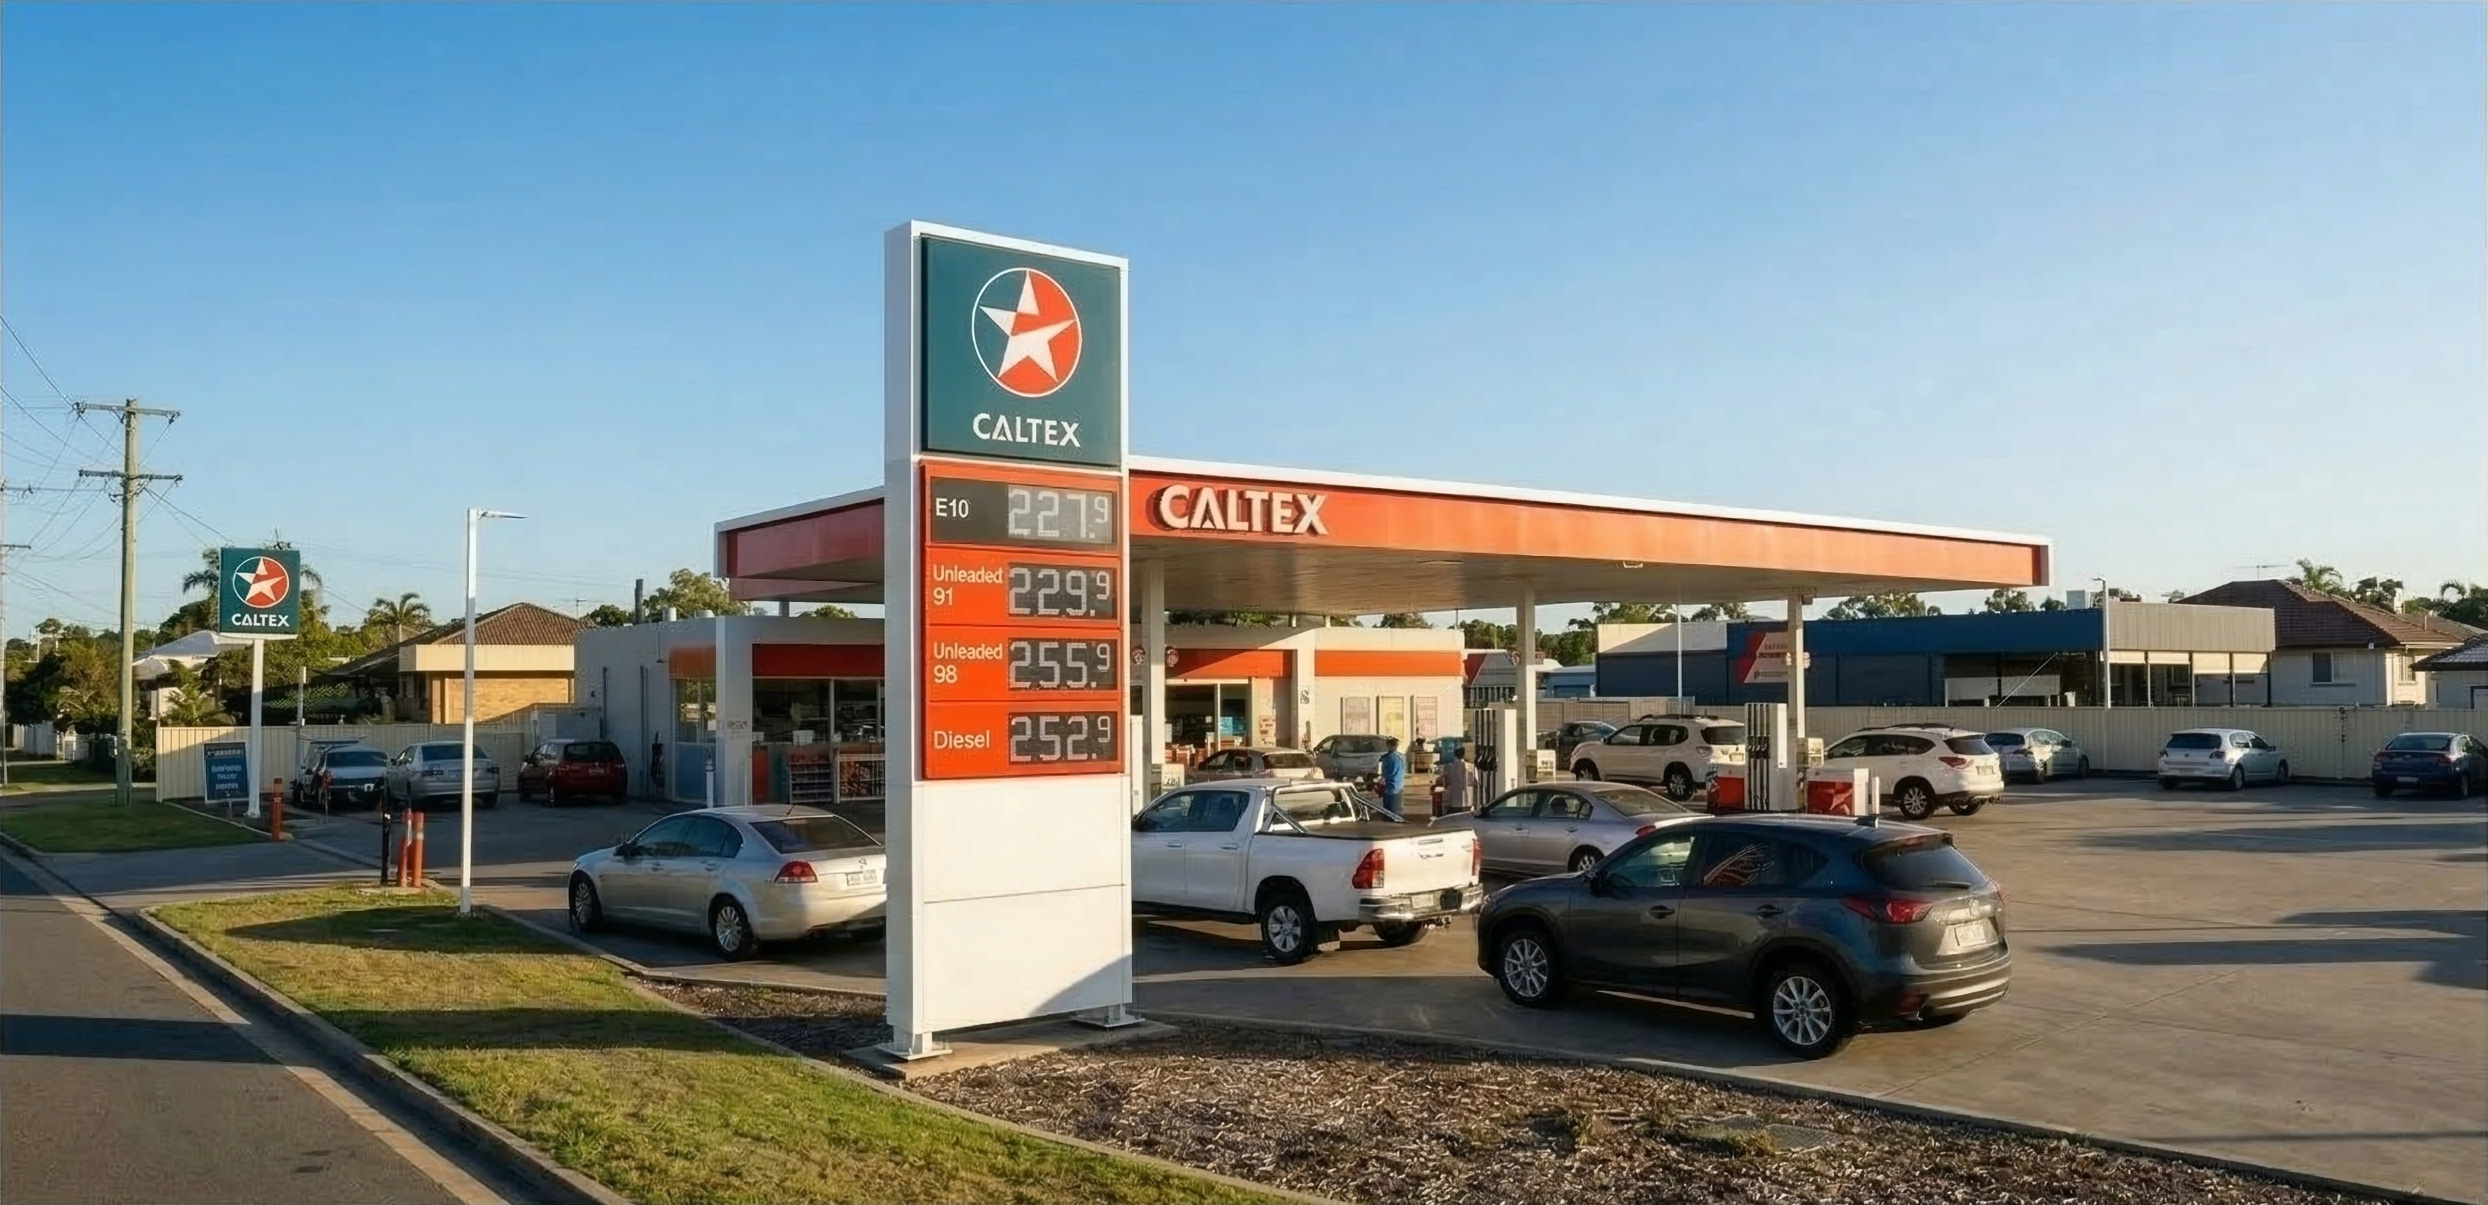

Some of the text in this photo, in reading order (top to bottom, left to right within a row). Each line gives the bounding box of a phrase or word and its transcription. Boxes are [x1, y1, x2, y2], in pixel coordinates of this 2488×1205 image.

[972, 412, 1081, 448] CALTEX
[935, 497, 969, 519] E10
[1008, 488, 1109, 539] 227.9
[1158, 484, 1329, 535] CALTEX
[932, 565, 1003, 584] Unleaded
[933, 587, 954, 607] 91
[1008, 566, 1111, 617] 229.9
[231, 612, 290, 628] CALTEX
[932, 642, 1003, 661] Unleaded
[933, 664, 958, 684] 98
[1009, 640, 1111, 689] 255.9
[933, 730, 991, 749] Diesel
[1009, 715, 1111, 763] 252.9
